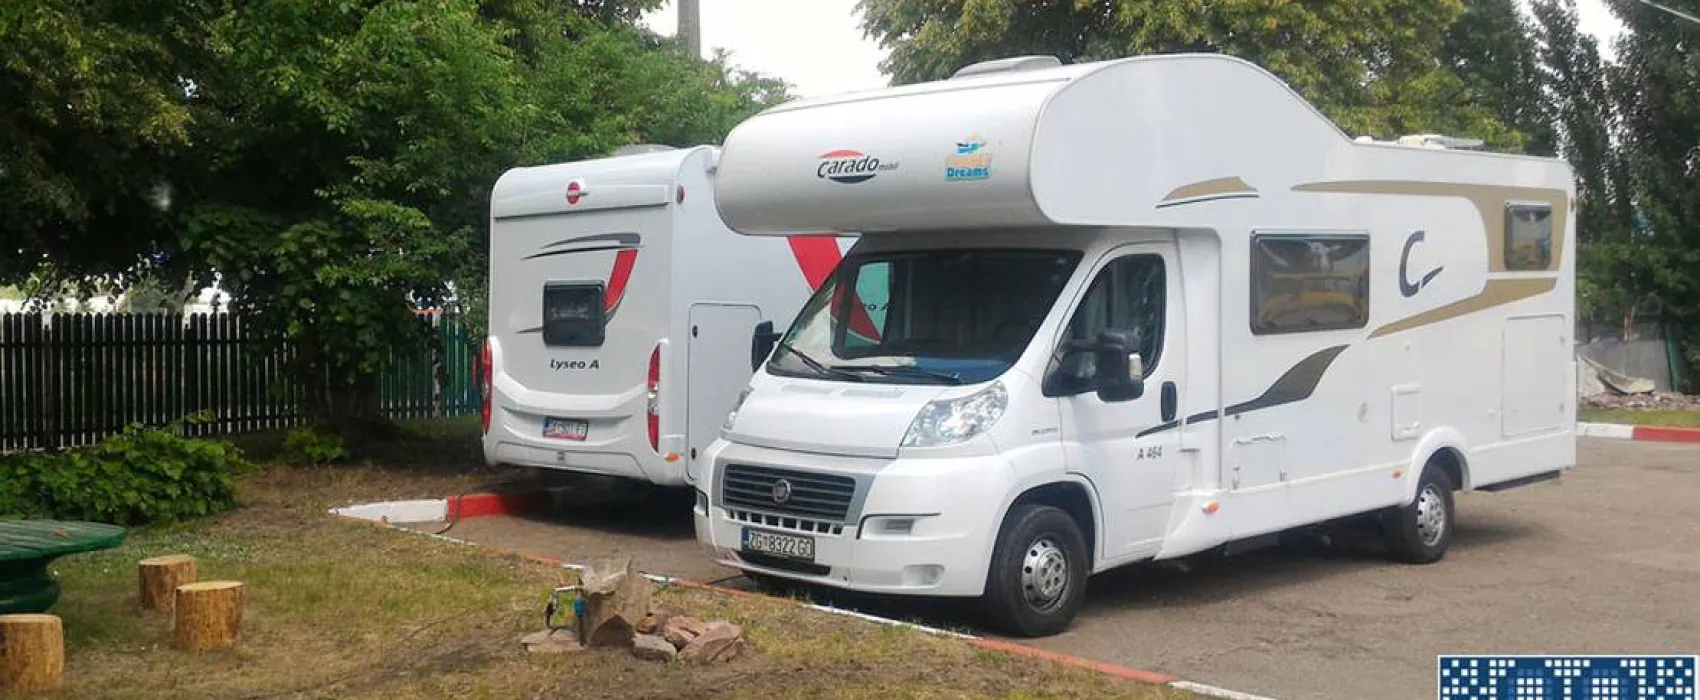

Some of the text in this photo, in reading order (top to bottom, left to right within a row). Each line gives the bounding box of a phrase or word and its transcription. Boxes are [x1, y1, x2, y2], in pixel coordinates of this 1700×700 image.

[947, 167, 989, 177] Dreams
[550, 359, 600, 370] Lyseo A
[1137, 447, 1144, 460] A
[769, 535, 796, 554] 8322
